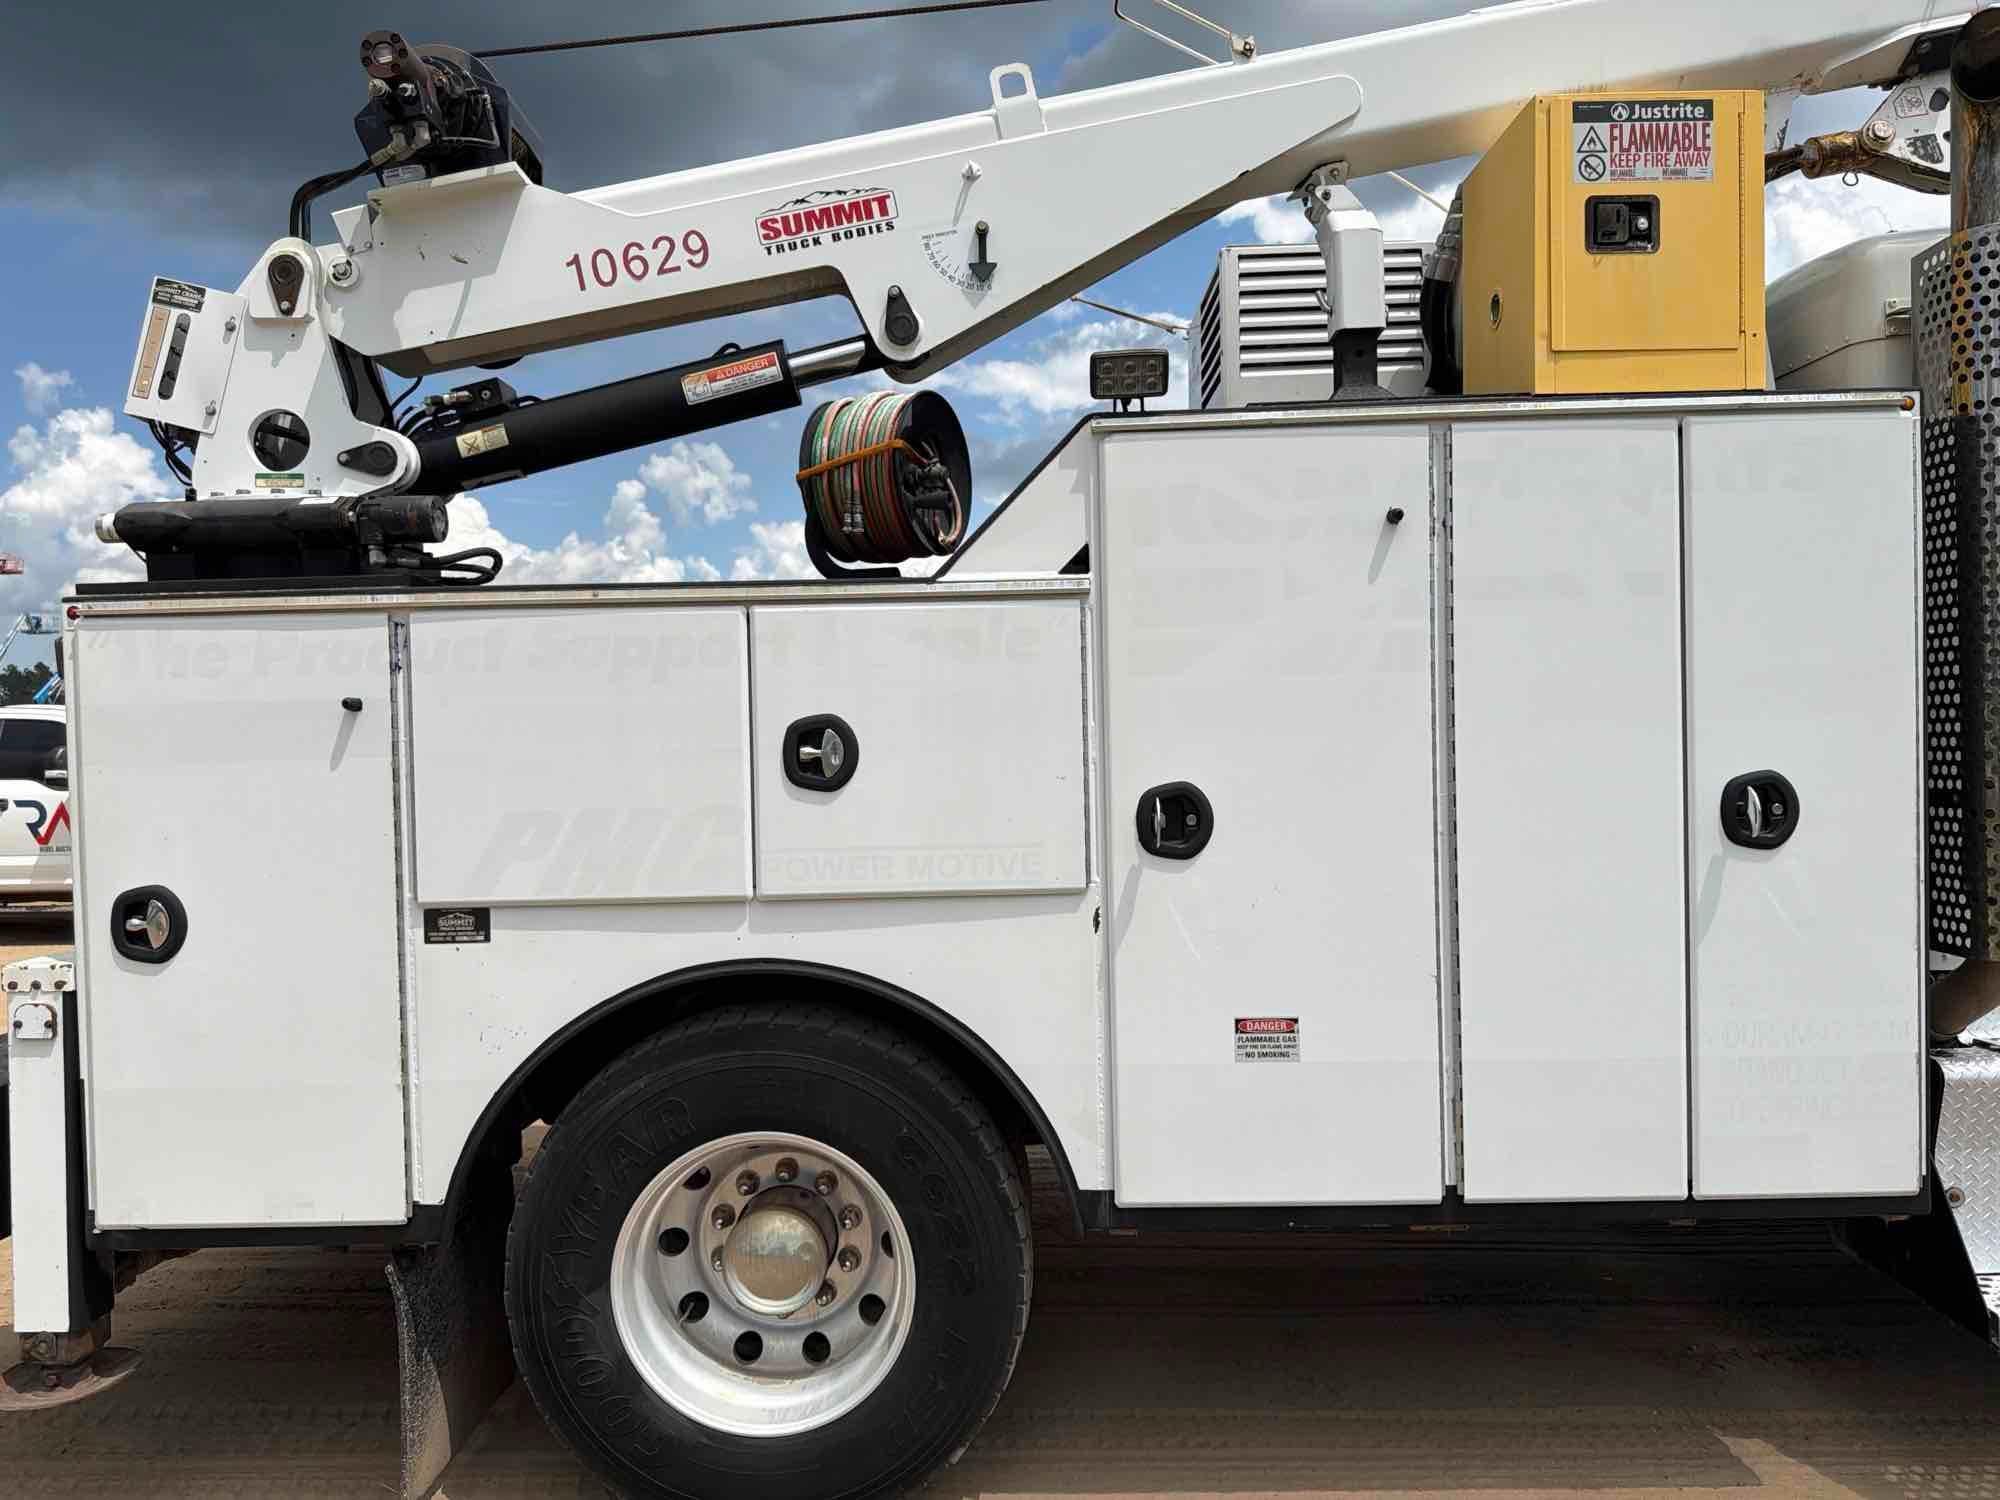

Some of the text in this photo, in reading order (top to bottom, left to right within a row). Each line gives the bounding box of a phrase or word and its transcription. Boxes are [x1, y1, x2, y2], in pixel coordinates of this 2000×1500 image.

[1631, 103, 1705, 119] Justrite
[1609, 122, 1711, 153] FLAMMABLE
[1609, 152, 1711, 169] KEEP FIRE AWAY
[759, 194, 892, 241] SUMMIT
[764, 235, 822, 256] TRUCK
[831, 220, 896, 244] BODIES
[565, 229, 710, 292] 10629
[725, 359, 769, 377] DANGER
[906, 848, 1041, 880] MOTIVE
[1246, 1021, 1287, 1031] DANGER
[1238, 1035, 1281, 1043] FLAMMABLE
